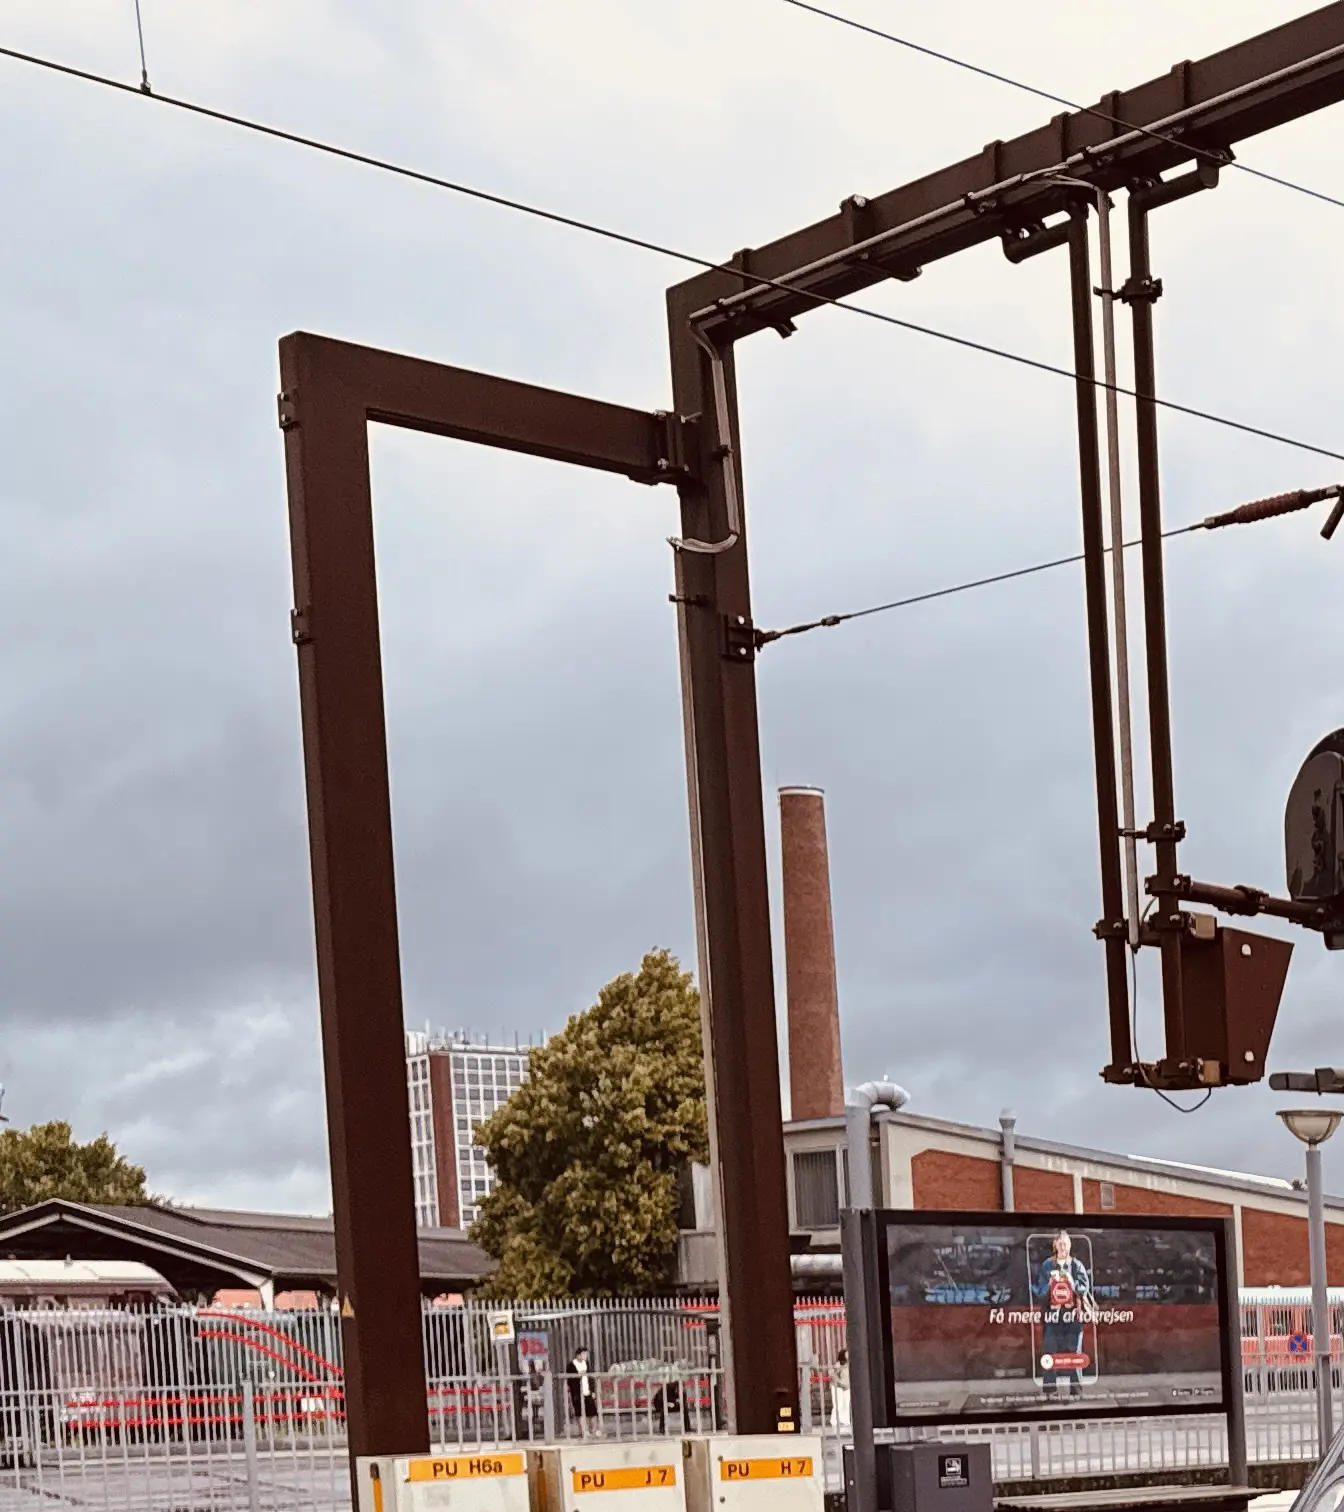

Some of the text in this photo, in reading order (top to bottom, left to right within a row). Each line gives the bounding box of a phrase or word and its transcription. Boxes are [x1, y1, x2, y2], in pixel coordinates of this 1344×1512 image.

[1008, 1309, 1041, 1324] mere
[1044, 1307, 1060, 1324] ud
[1063, 1308, 1078, 1324] af
[1079, 1307, 1134, 1326] togrejsen
[432, 1458, 503, 1478] PU H6a
[727, 1462, 750, 1478] PU
[580, 1473, 605, 1490] PU
